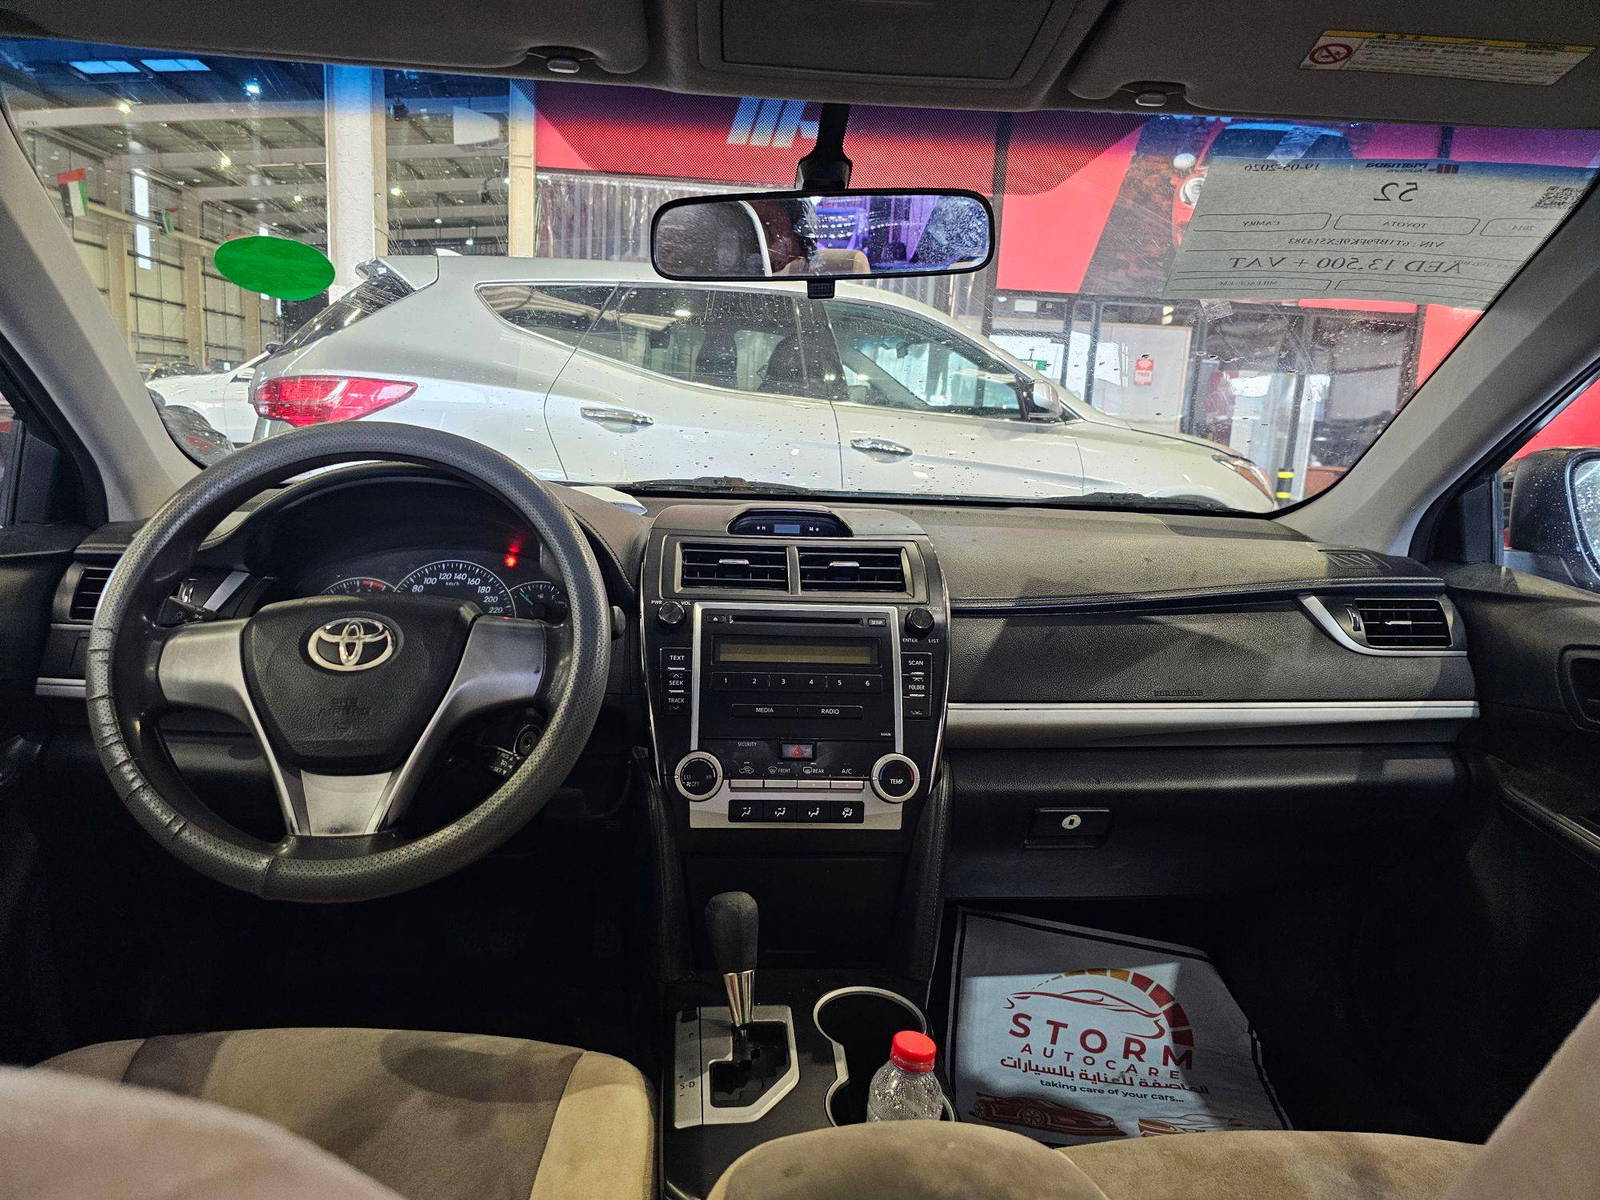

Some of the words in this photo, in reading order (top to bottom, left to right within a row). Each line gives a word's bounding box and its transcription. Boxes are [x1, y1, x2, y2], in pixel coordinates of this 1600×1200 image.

[423, 577, 437, 585] 100
[467, 578, 481, 586] 160
[412, 585, 424, 593] 80
[477, 586, 491, 594] 180
[488, 606, 503, 614] 220
[1009, 1012, 1193, 1070] STORM
[1020, 1043, 1179, 1079] AUTOCARE
[1000, 1056, 1074, 1081] بالسيارات
[1039, 1079, 1078, 1092] taking
[1080, 1085, 1105, 1095] care
[1108, 1087, 1119, 1095] of
[1121, 1090, 1148, 1100] your
[1150, 1093, 1184, 1103] cars...
